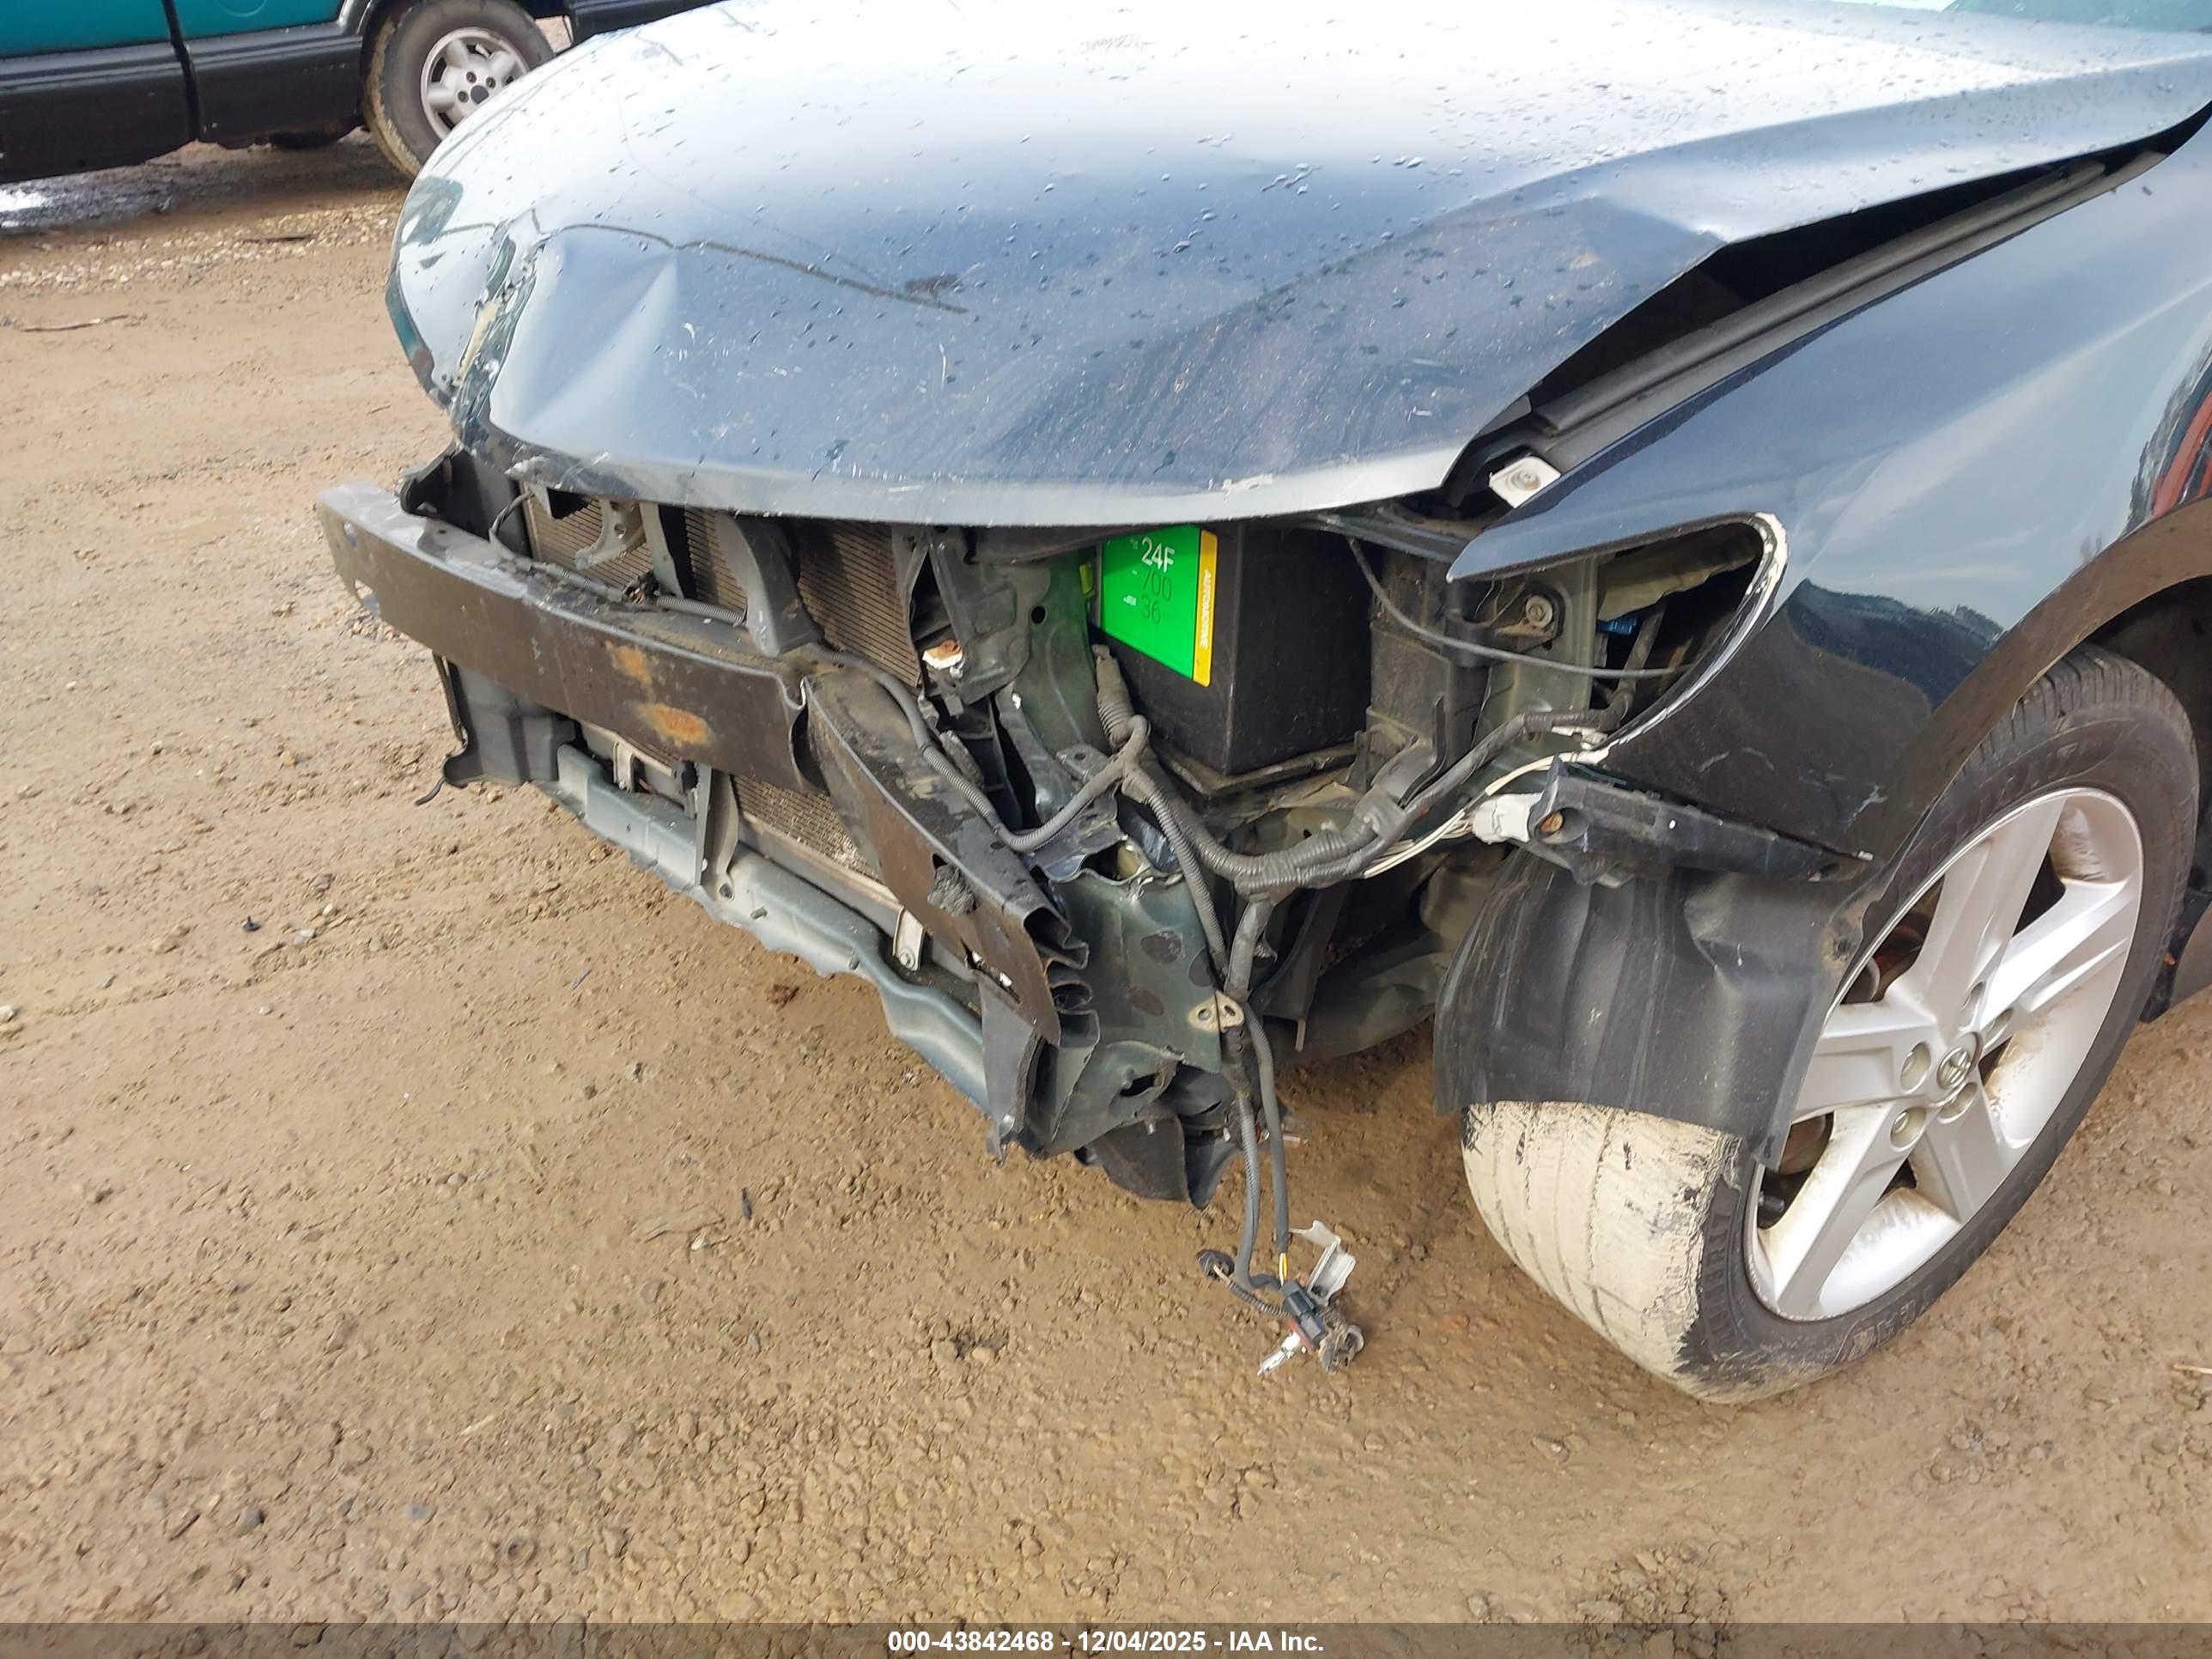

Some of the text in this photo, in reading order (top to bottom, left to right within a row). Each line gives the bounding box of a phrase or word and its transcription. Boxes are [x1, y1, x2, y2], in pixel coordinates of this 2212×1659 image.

[1141, 536, 1176, 574] 24F
[1141, 566, 1173, 603] 700
[1140, 594, 1162, 624] 36
